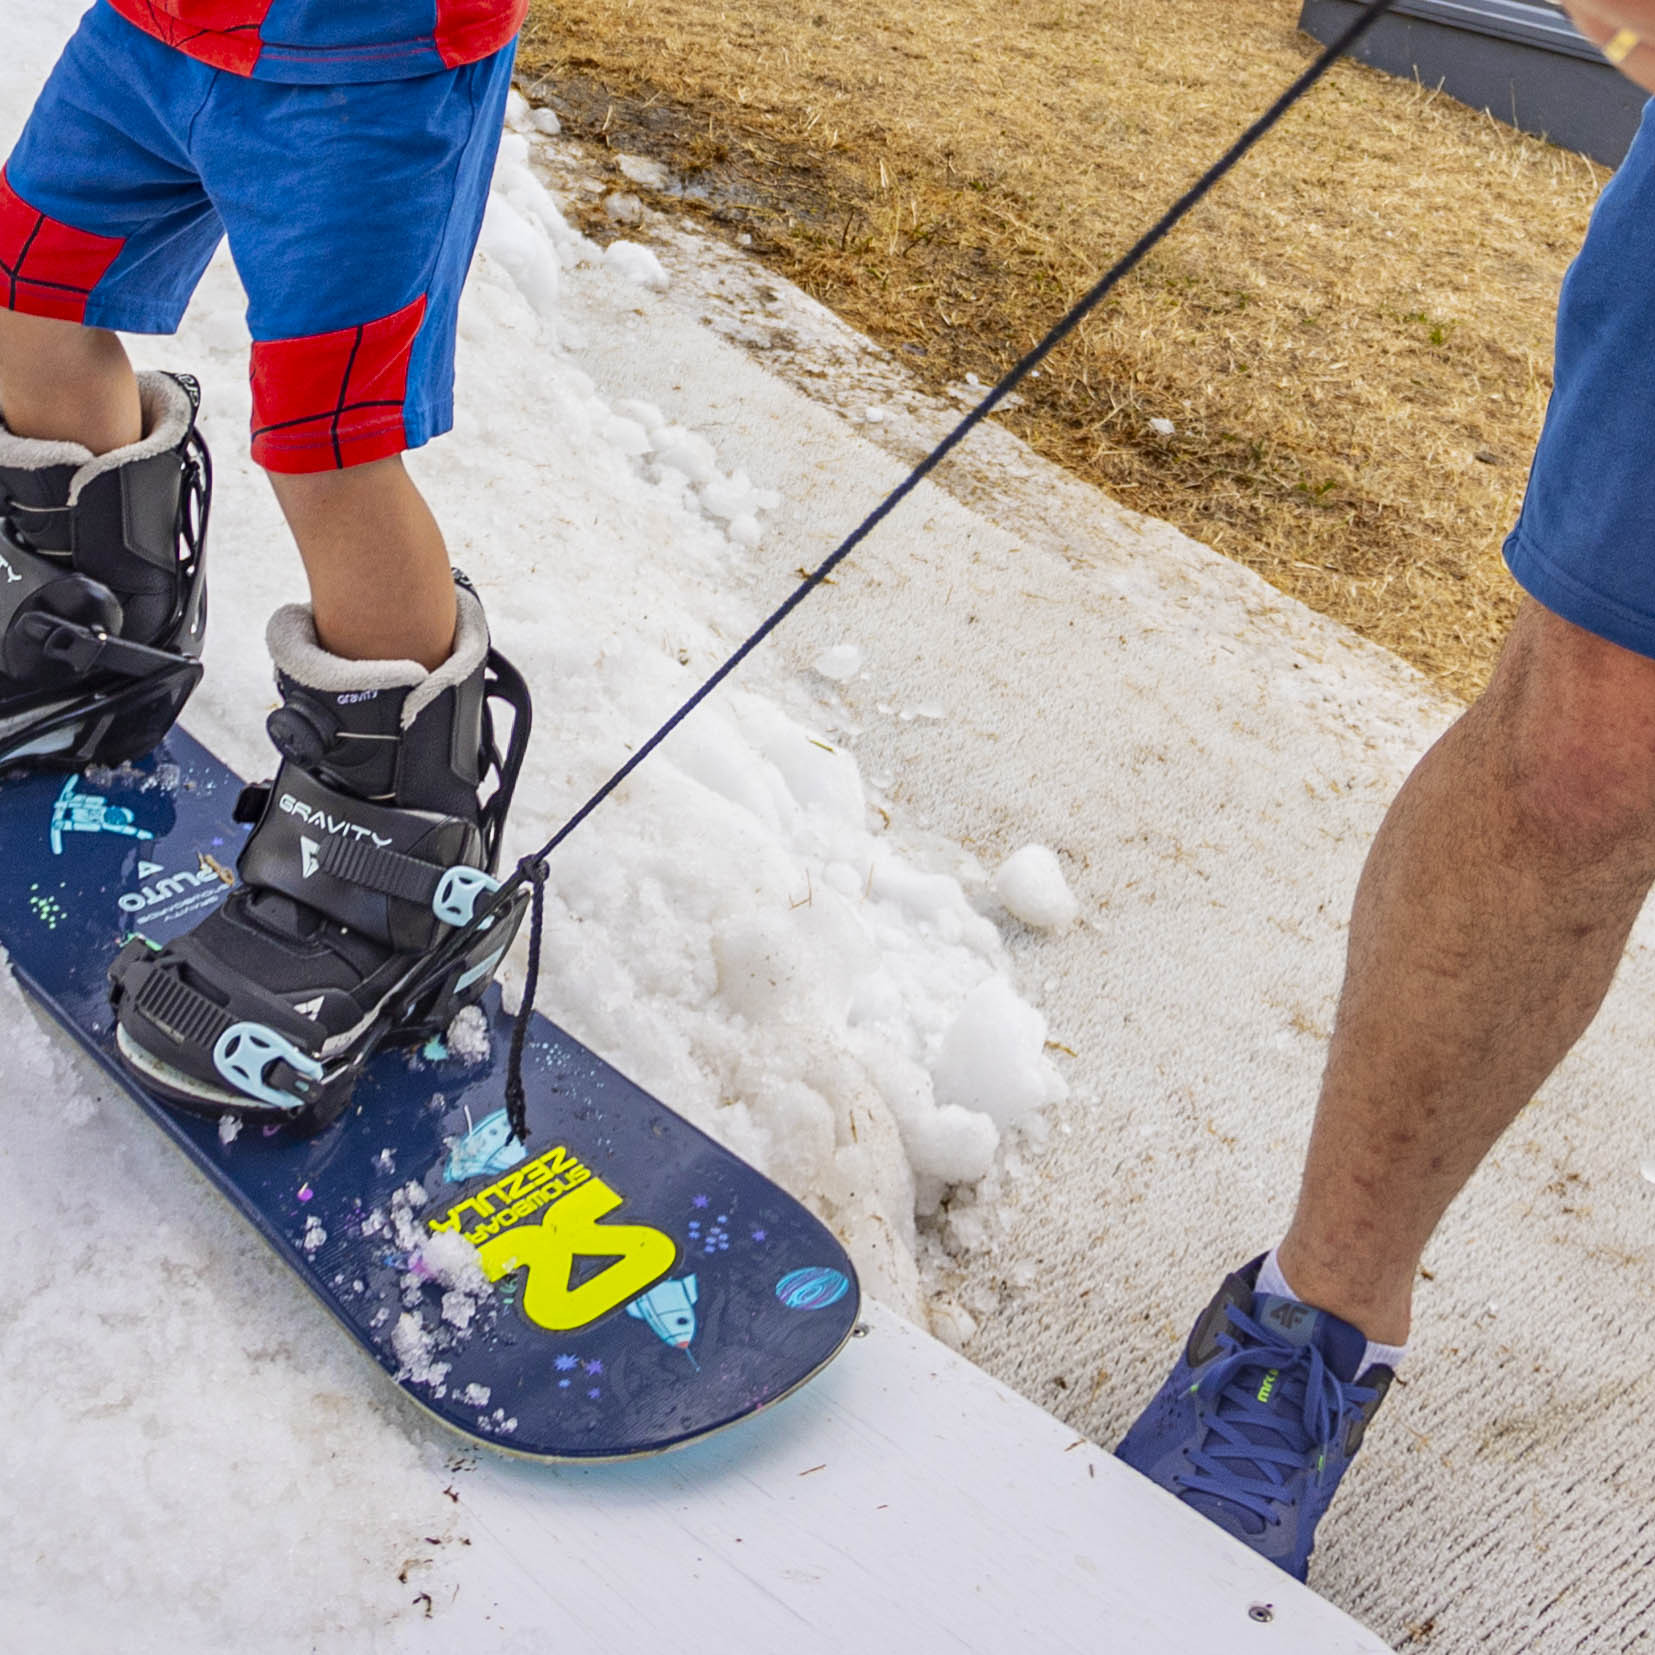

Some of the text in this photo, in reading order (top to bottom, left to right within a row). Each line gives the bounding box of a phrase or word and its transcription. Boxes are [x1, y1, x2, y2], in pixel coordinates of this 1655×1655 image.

[279, 793, 393, 849] GRAVITY
[429, 1145, 578, 1234] ZEZULA
[463, 1162, 593, 1245] SNOWBOAR
